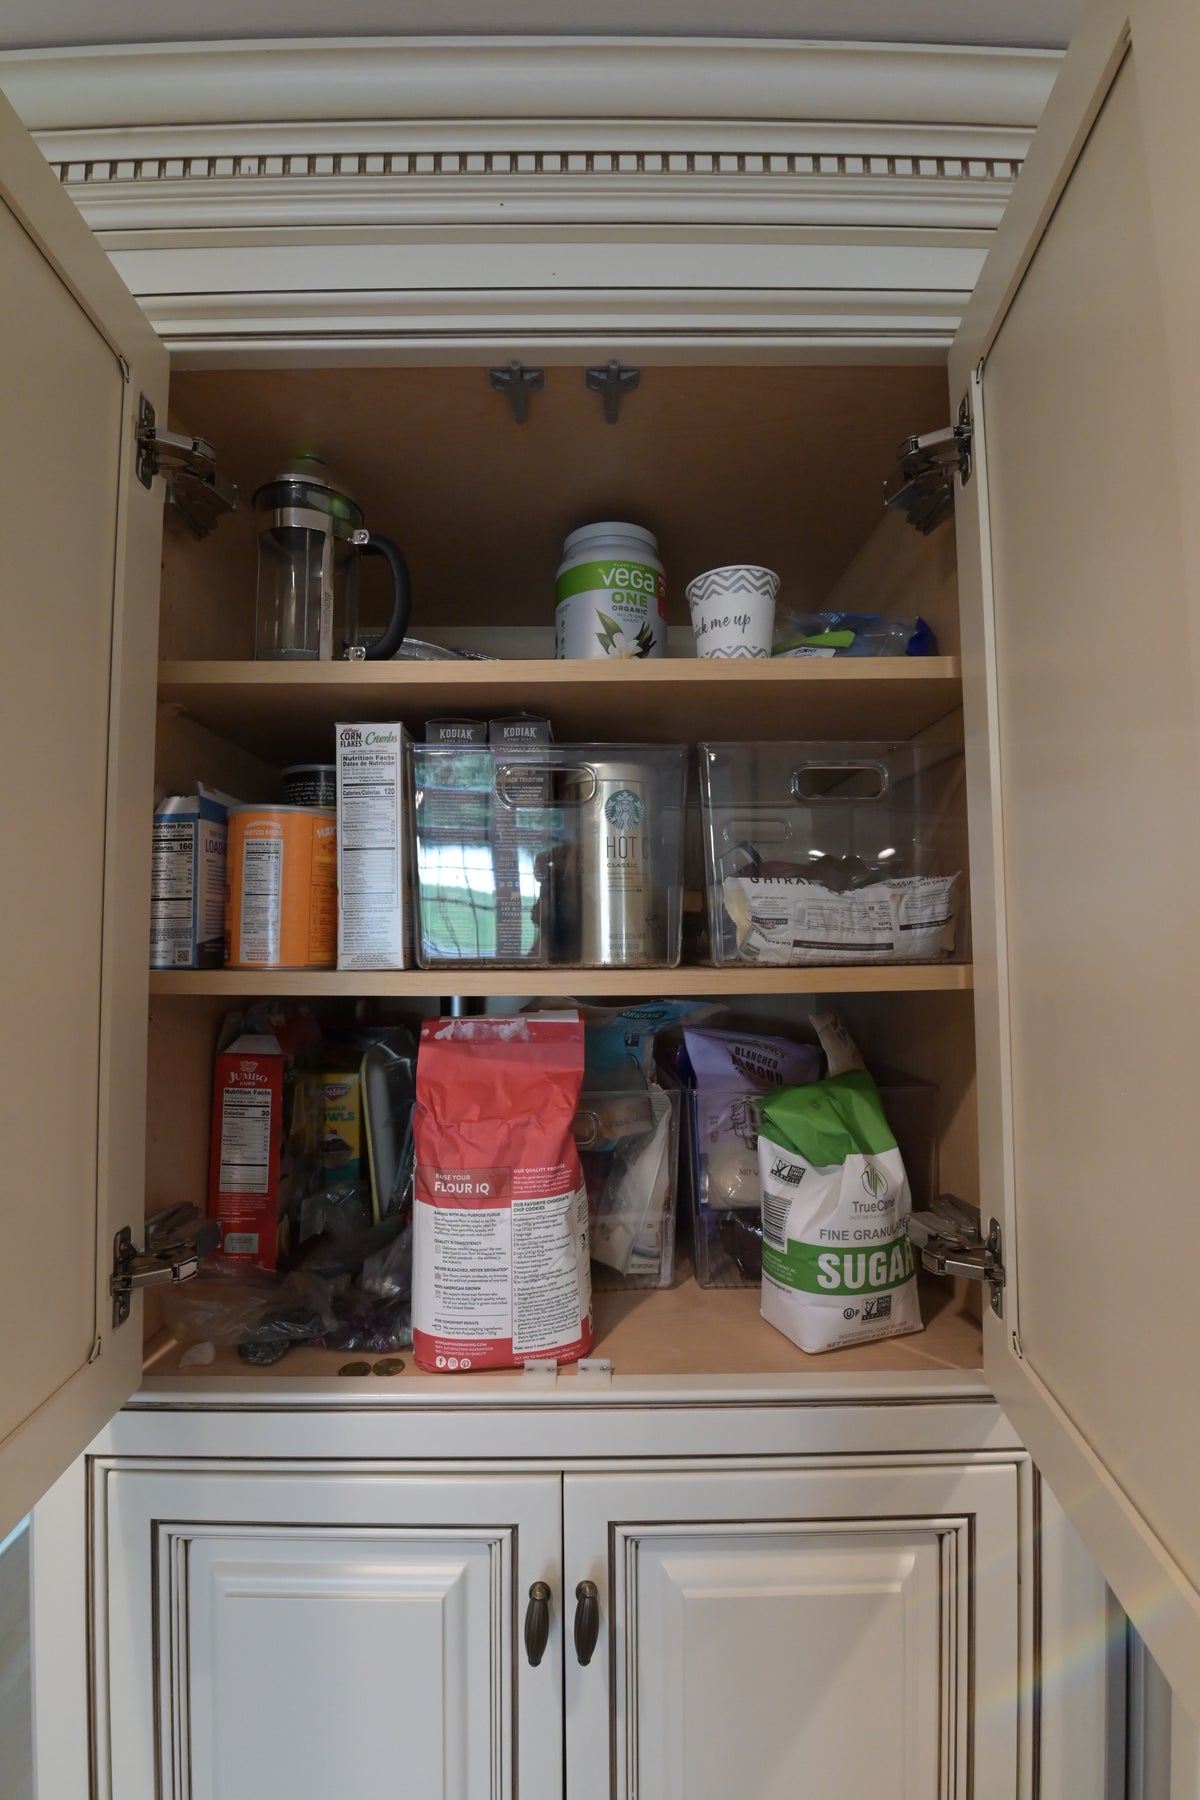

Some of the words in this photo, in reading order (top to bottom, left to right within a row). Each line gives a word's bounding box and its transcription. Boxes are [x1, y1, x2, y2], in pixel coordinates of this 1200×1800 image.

[611, 591, 648, 609] ONE
[612, 605, 648, 616] ORGANIC
[710, 616, 730, 630] me
[734, 614, 751, 634] up
[340, 732, 362, 741] CORN
[365, 731, 397, 746] Crumbs
[440, 728, 473, 740] KODIAK
[504, 727, 537, 738] KODIAK
[340, 740, 362, 748] FLAKES
[384, 787, 396, 796] 120
[606, 836, 637, 859] HOT
[734, 1046, 779, 1070] BLANCHED
[228, 1071, 268, 1084] JUMBO
[434, 1181, 473, 1194] FLOUR
[475, 1182, 490, 1196] IQ
[524, 1199, 546, 1207] FAVORITE
[820, 1229, 850, 1241] FINE
[853, 1216, 911, 1241] GRANULATE
